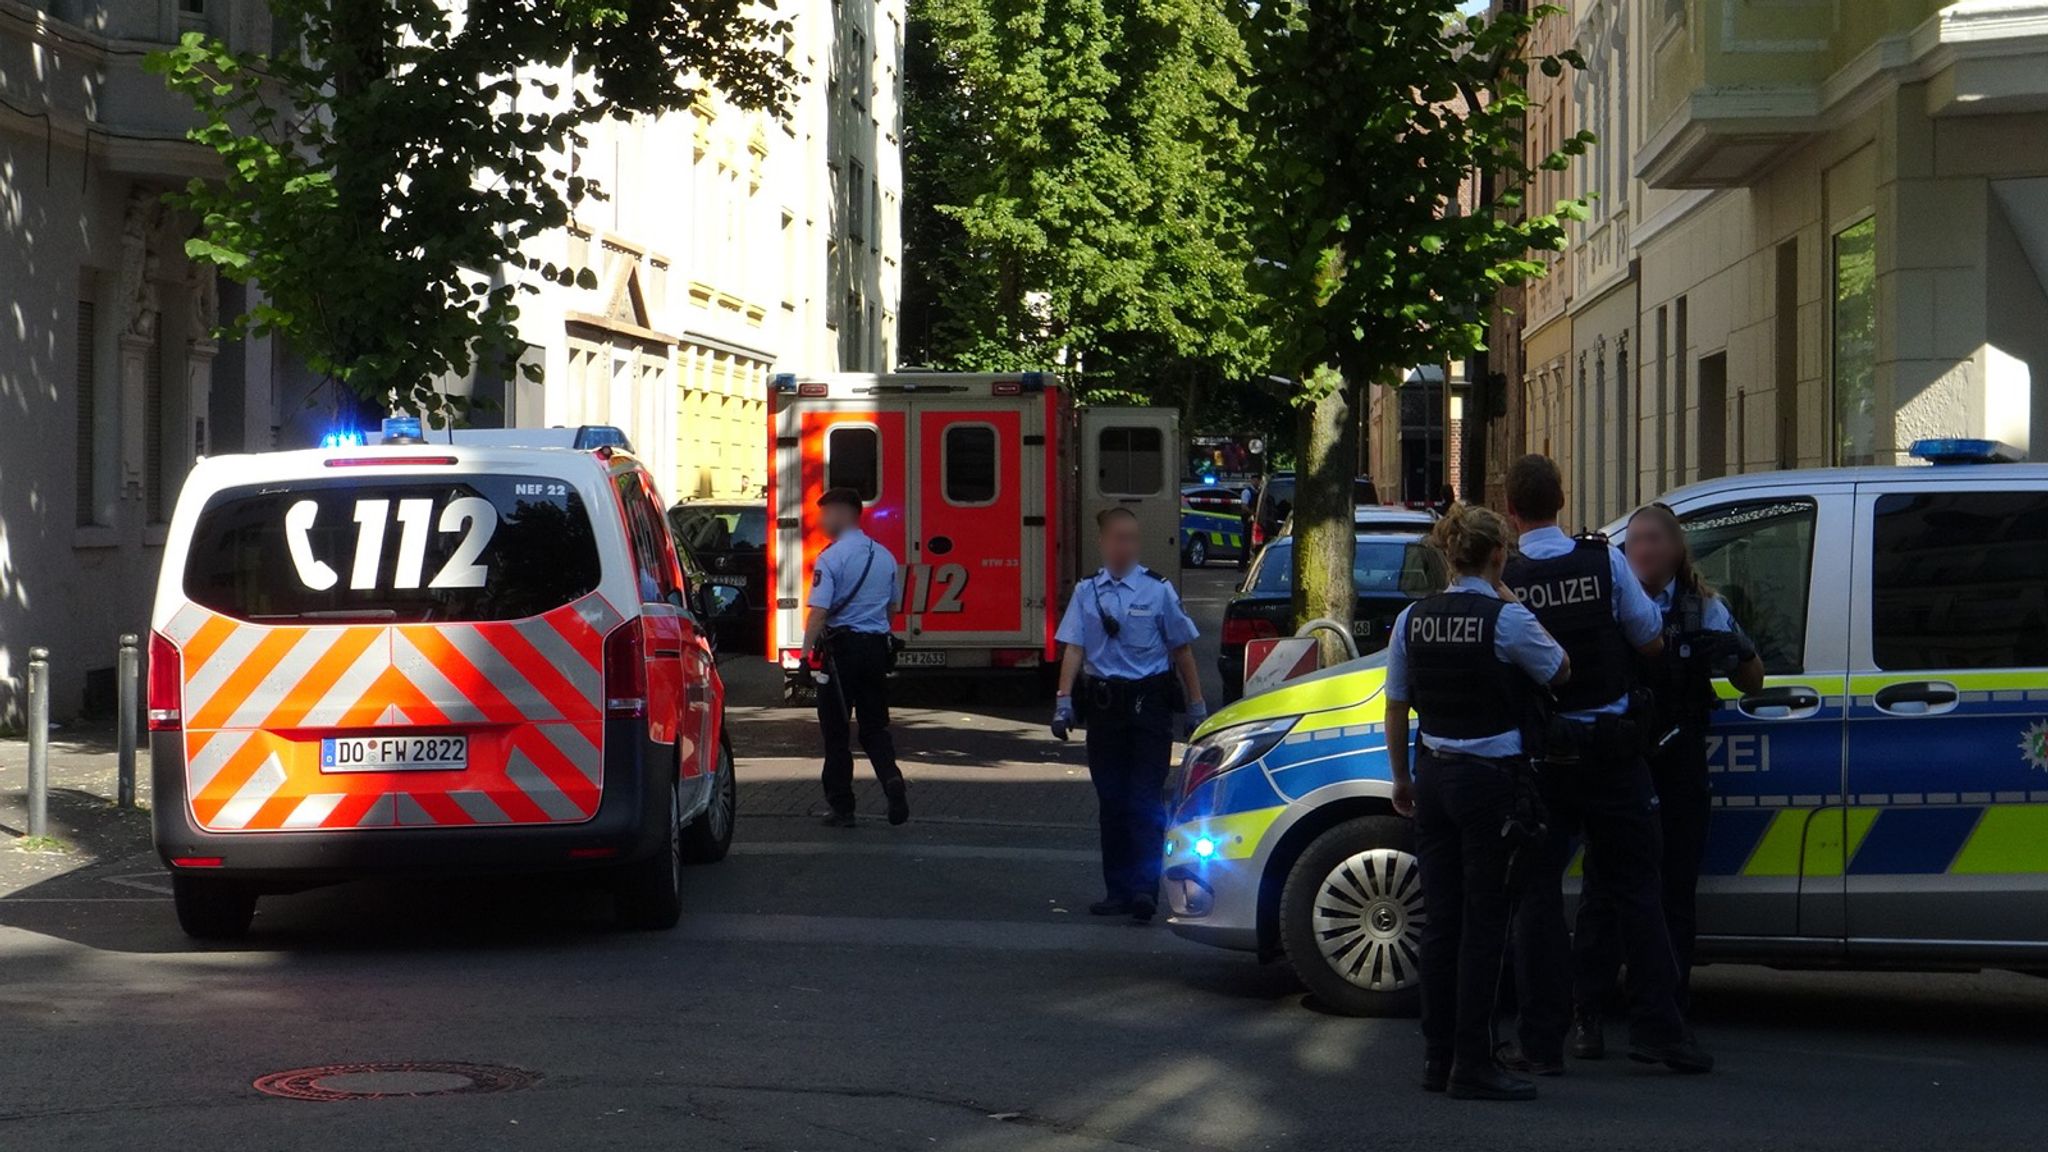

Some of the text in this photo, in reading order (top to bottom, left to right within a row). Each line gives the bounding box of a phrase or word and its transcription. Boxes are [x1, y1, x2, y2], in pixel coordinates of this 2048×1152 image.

[515, 484, 566, 496] NEF 22
[350, 496, 499, 590] 112
[1513, 575, 1601, 608] POLIZEI
[1410, 617, 1484, 642] POLIZEI
[919, 653, 945, 664] 2633
[339, 742, 364, 763] DO
[381, 740, 407, 762] FW
[413, 739, 464, 762] 2822
